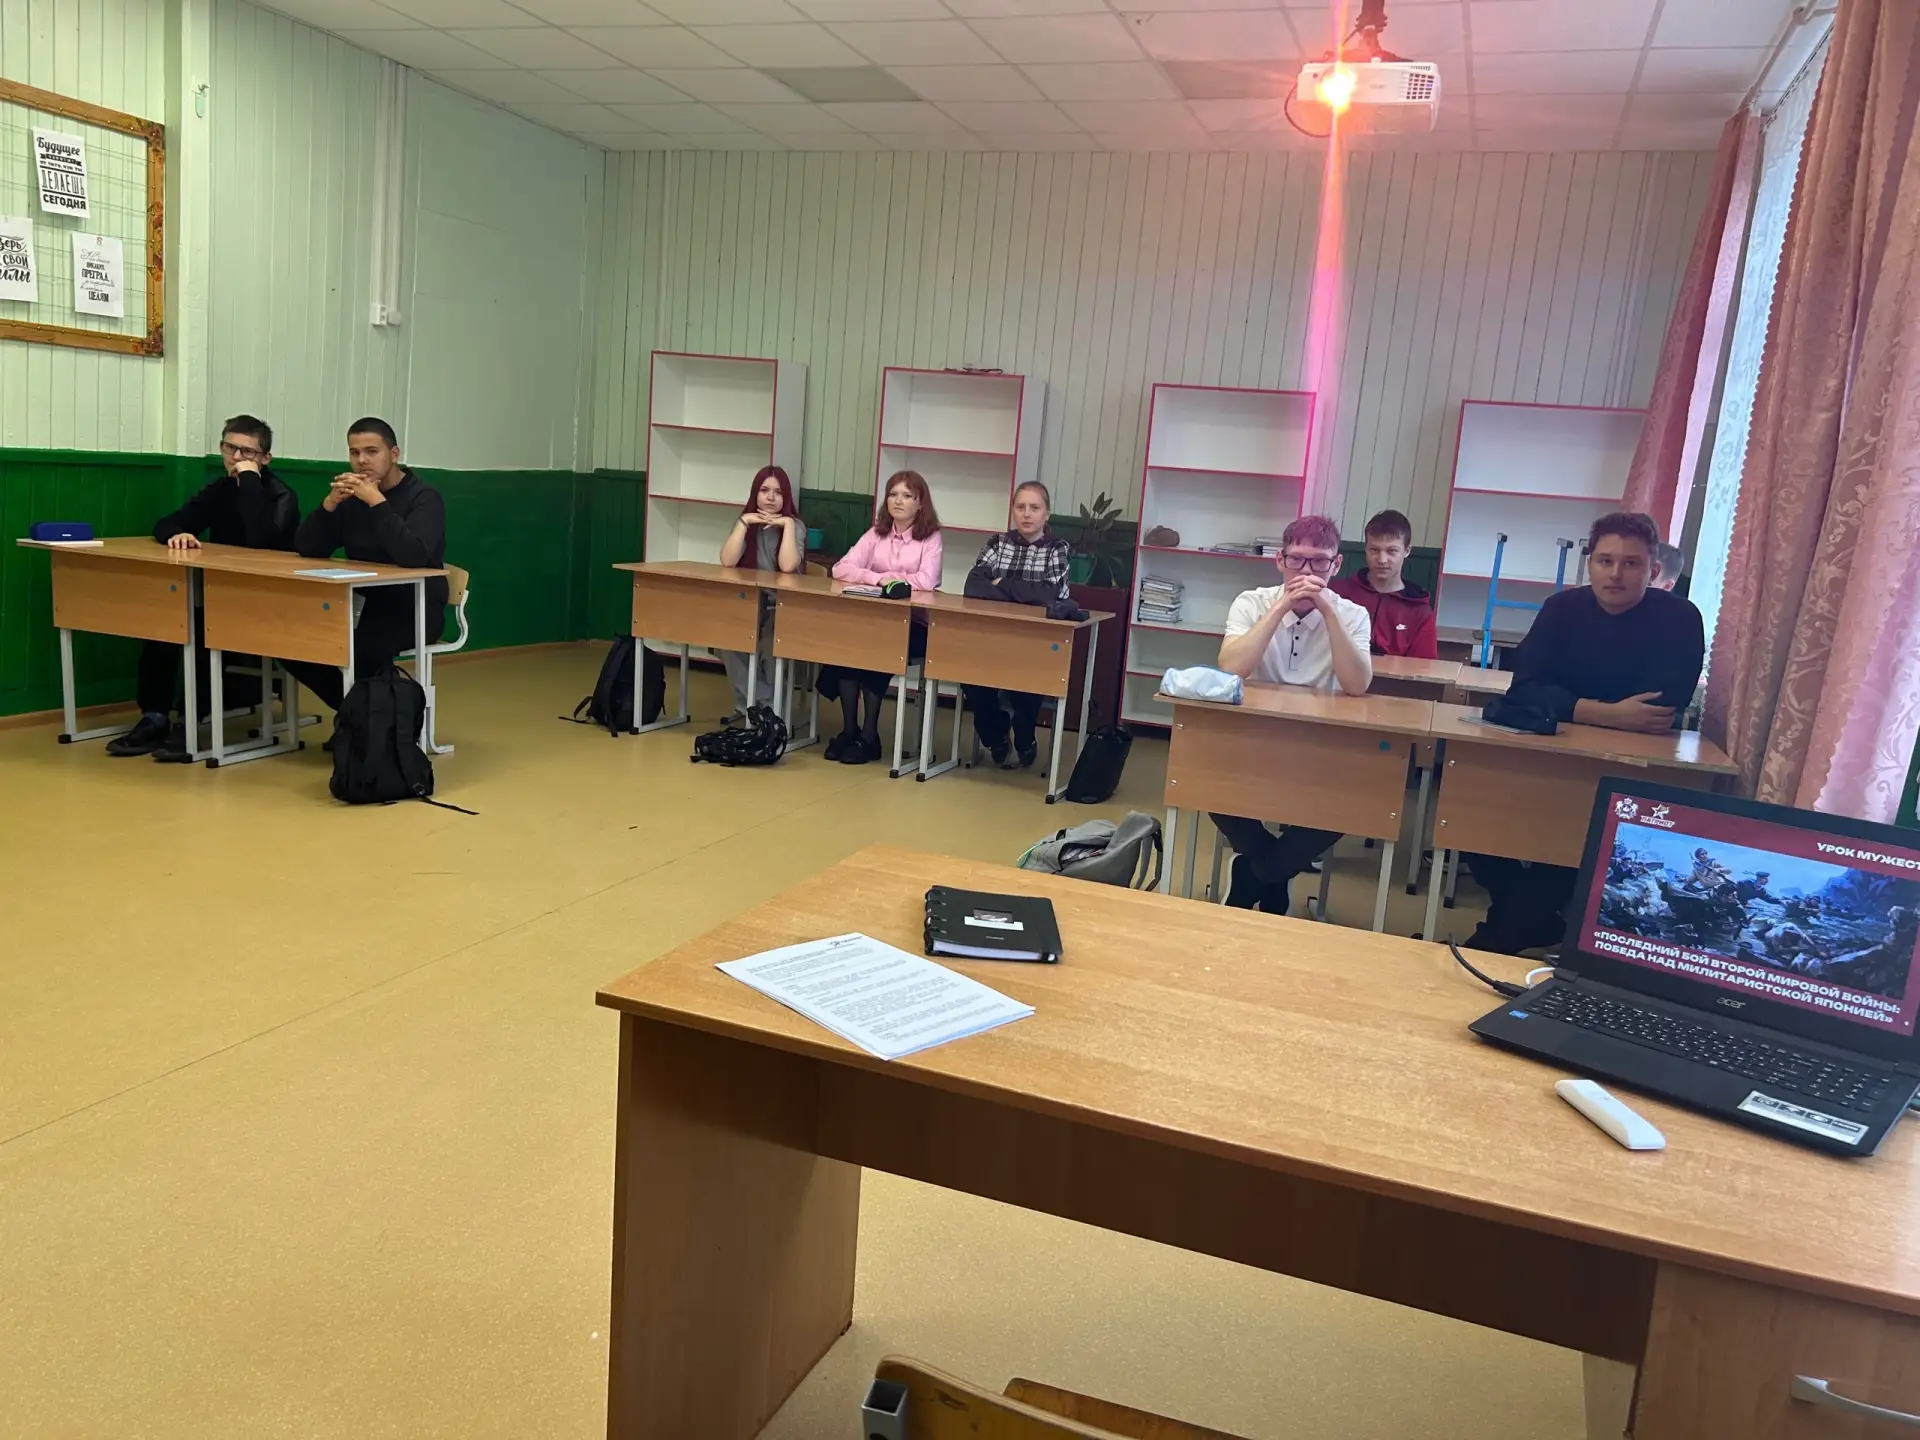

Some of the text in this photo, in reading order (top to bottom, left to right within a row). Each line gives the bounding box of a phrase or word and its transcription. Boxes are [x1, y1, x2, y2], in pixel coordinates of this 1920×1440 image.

[36, 136, 81, 156] Будущее
[41, 169, 85, 195] ДЕЛАЕШЬ
[43, 193, 86, 210] СЕГОДНЯ
[1817, 842, 1856, 858] УРОК
[1593, 931, 1901, 1014] «ПОСЛЕДНИЙ БОЙ ВТОРОЙ МИРОВОЙ ВОЙНЫ:
[1594, 940, 1894, 1023] ПОБЕДА НАД МИЛИТАРИСТСКОЙ ЯПОНИЕЙ»
[1716, 996, 1746, 1009] acer
